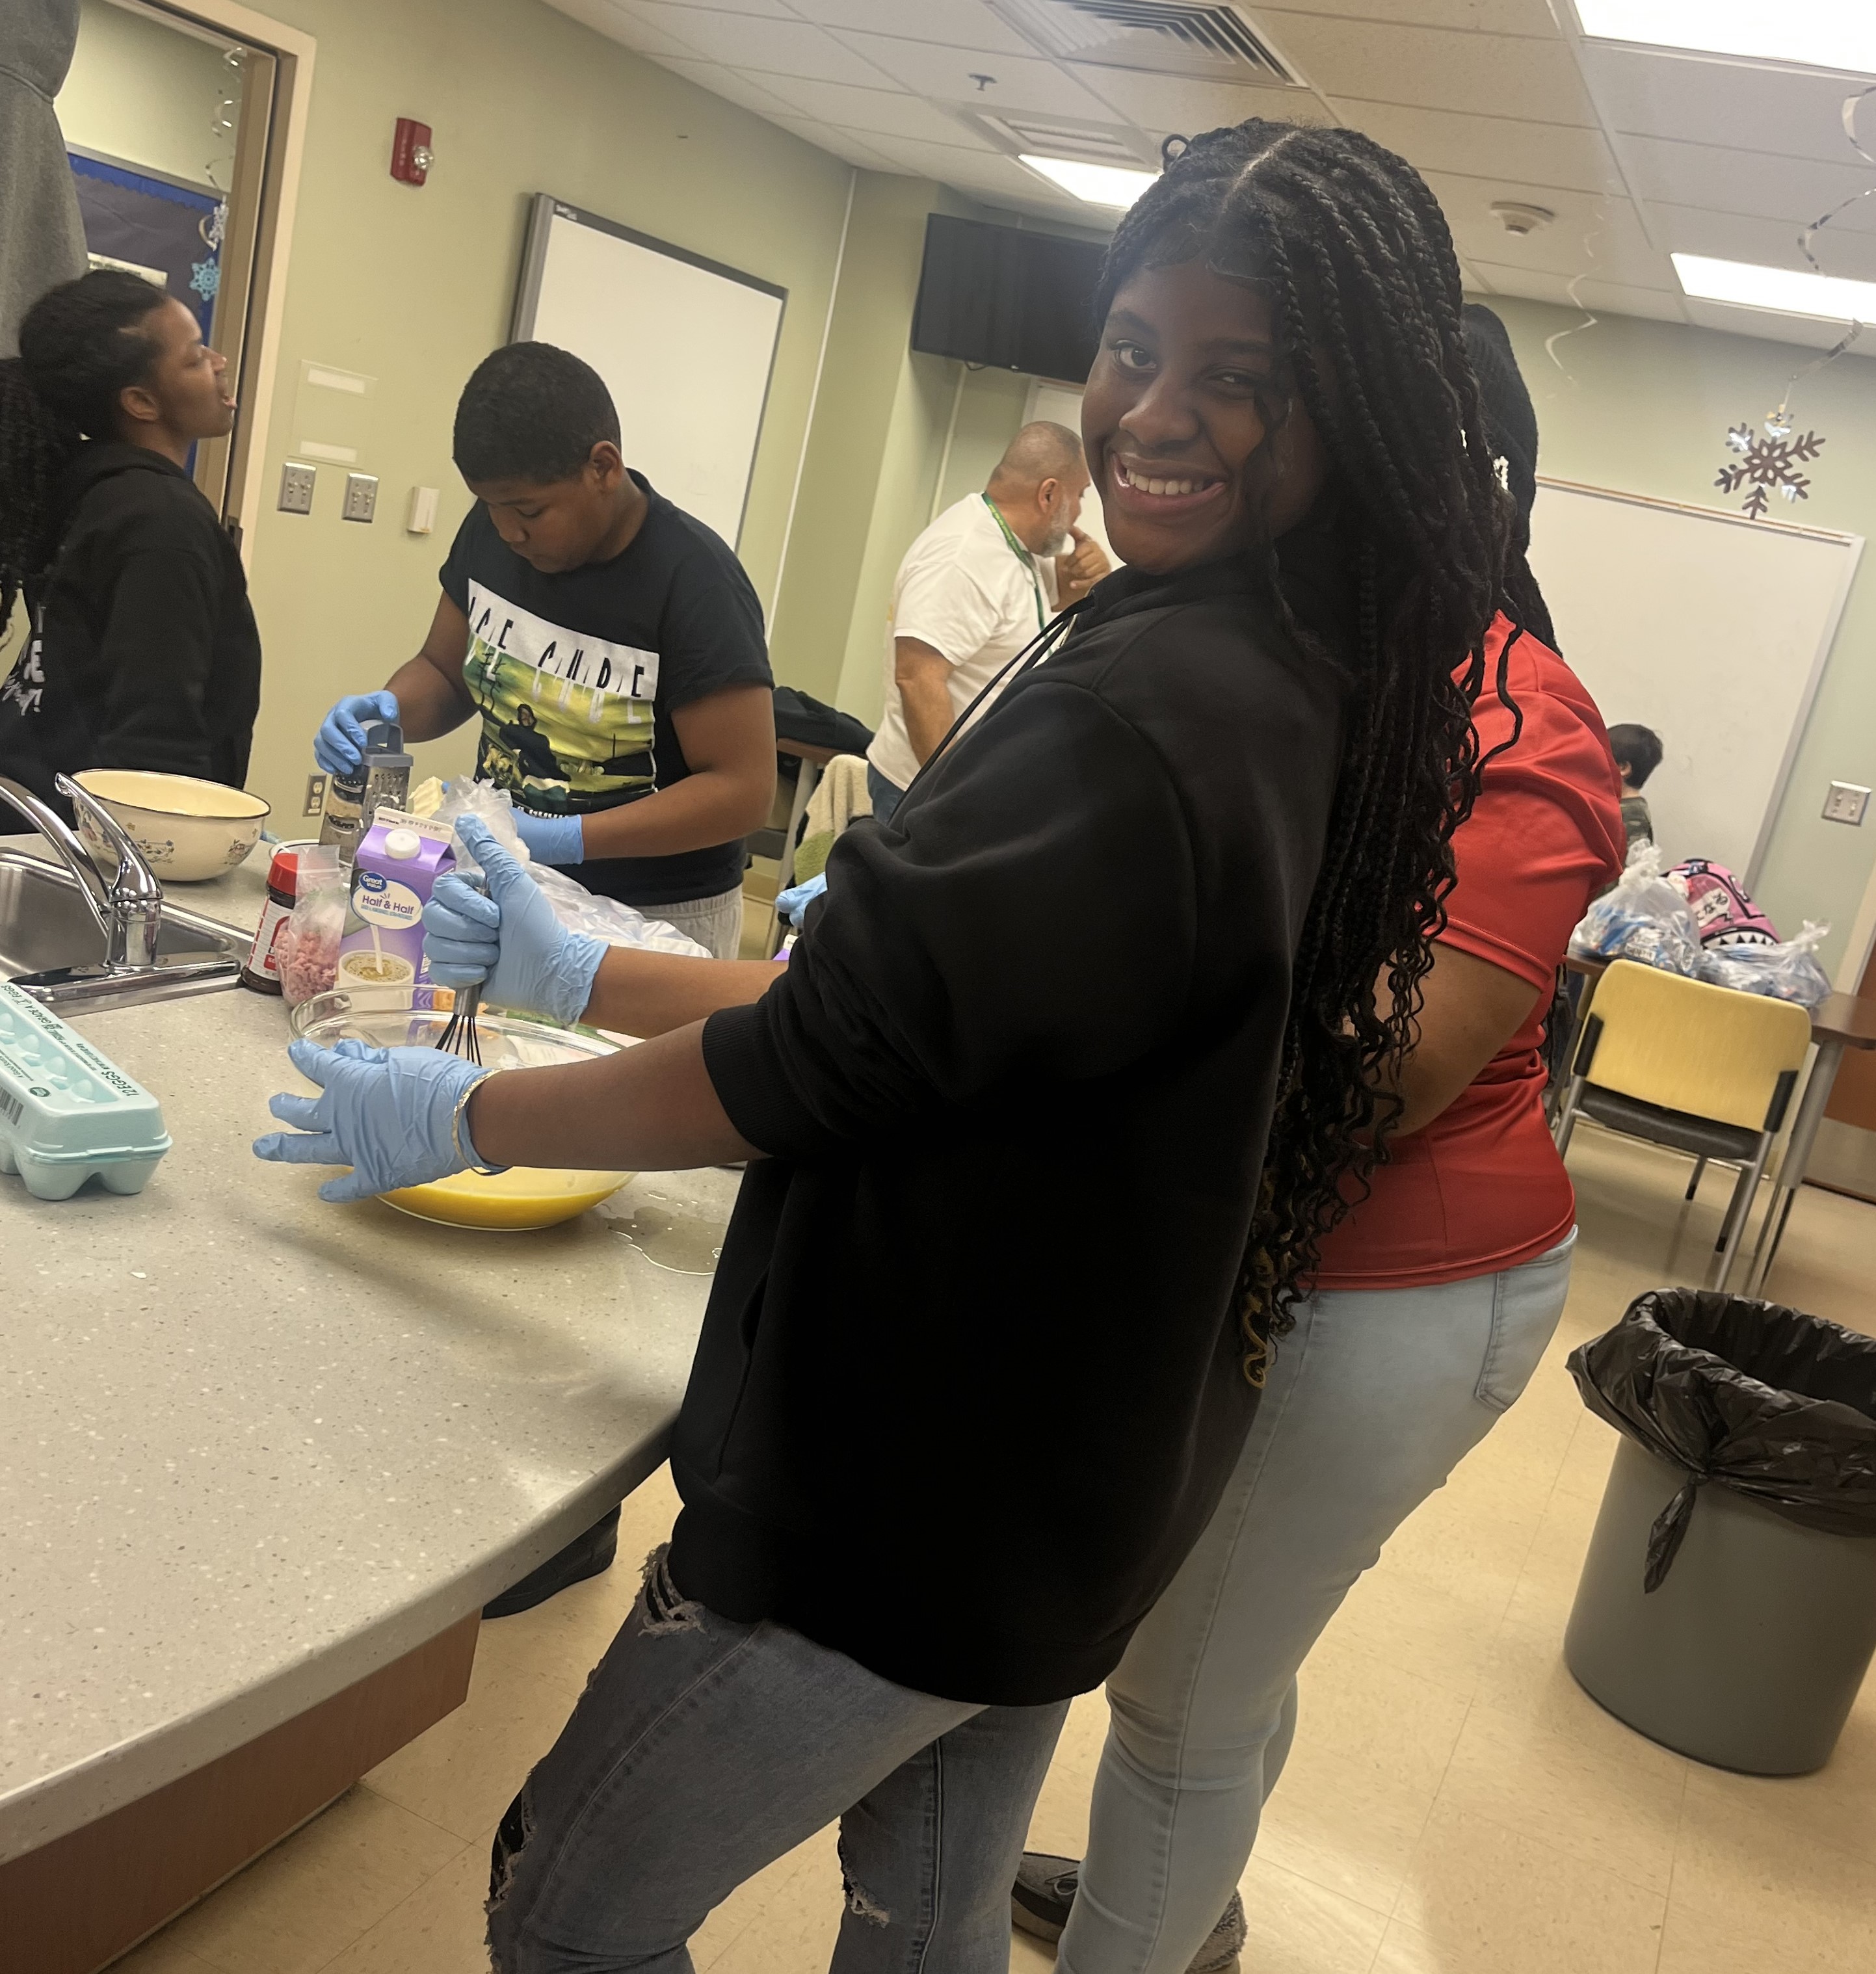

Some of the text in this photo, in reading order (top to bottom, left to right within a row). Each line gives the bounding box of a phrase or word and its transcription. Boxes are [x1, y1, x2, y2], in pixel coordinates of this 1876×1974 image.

[532, 640, 644, 724] CUBE
[362, 895, 382, 908] Half
[384, 900, 391, 909] &
[393, 902, 414, 915] Half
[100, 1070, 133, 1090] EGGS
